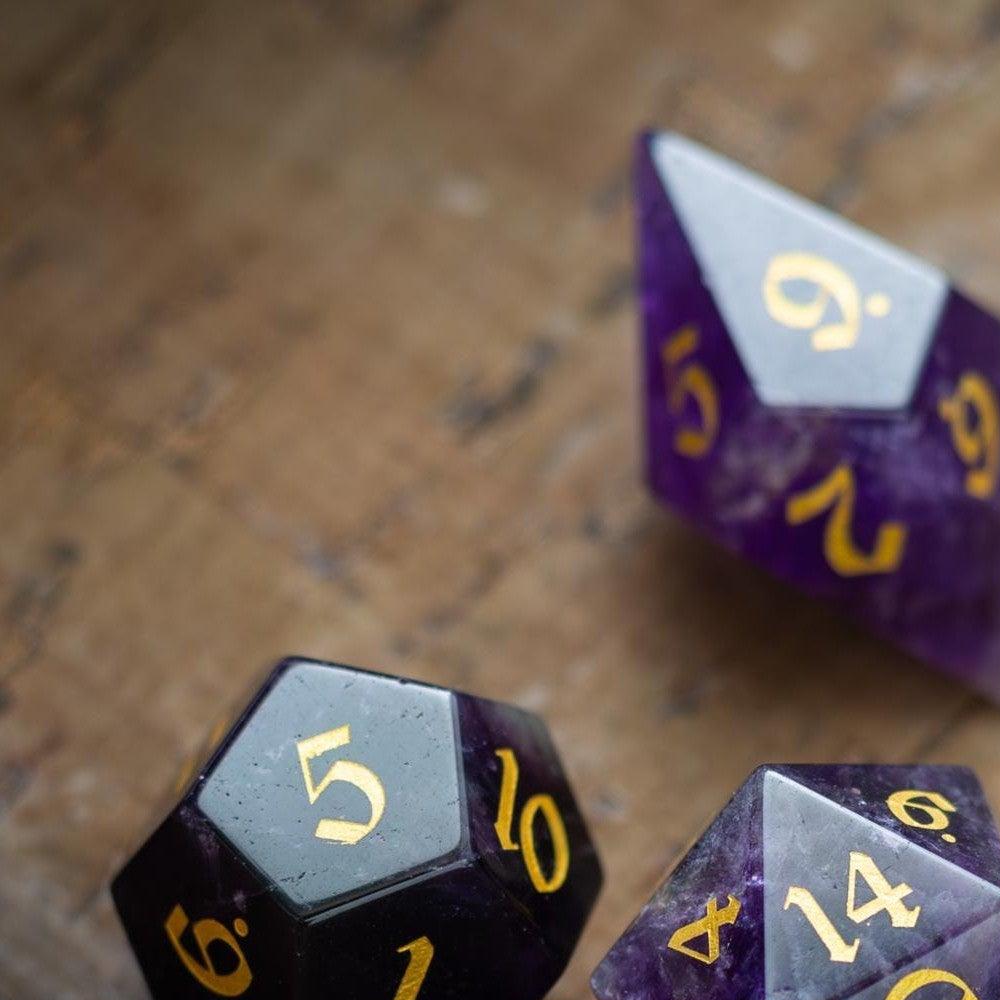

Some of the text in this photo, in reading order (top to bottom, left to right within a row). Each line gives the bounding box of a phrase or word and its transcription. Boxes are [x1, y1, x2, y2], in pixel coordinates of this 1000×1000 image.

[663, 327, 719, 457] 5
[786, 463, 907, 577] 2
[296, 724, 386, 845] 5
[494, 748, 570, 893] 10
[667, 895, 741, 965] 4
[784, 850, 921, 963] 14
